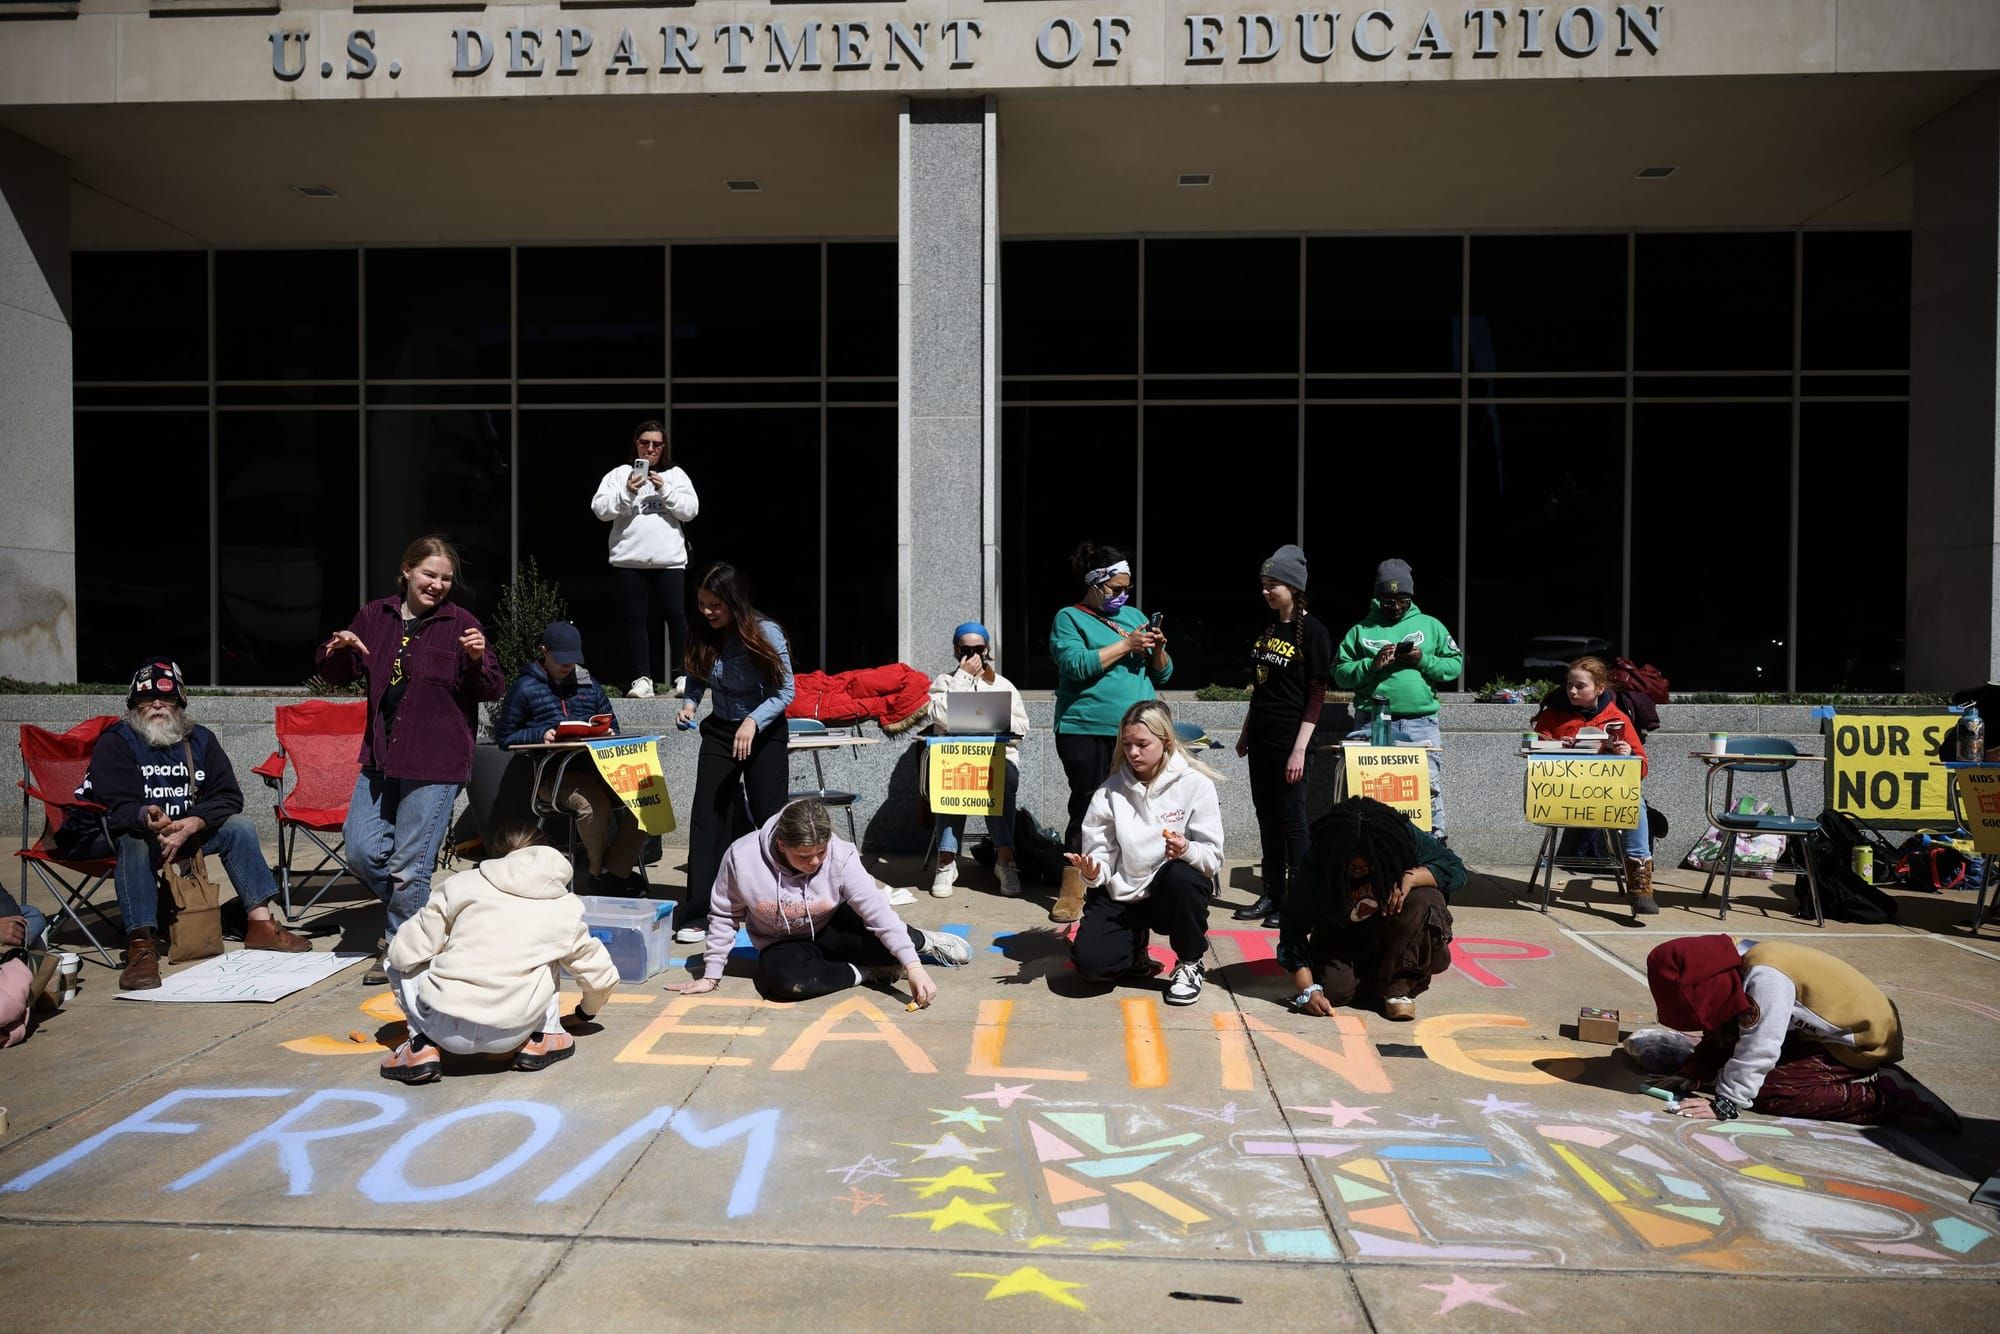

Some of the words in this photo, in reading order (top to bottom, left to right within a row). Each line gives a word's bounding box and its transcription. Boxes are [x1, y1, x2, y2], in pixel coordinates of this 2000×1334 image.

[267, 28, 402, 82] U.S.
[450, 19, 983, 78] DEPARTMENT
[1035, 17, 1132, 69] OF
[1183, 4, 1665, 65] EDUCATION
[940, 744, 960, 755] KIDS
[961, 745, 997, 756] DESERVE
[1836, 725, 1911, 757] OUR
[596, 747, 615, 760] KIDS
[615, 742, 648, 757] DESERVE
[1358, 755, 1379, 766] KIDS
[1381, 754, 1420, 766] DESERVE
[1589, 762, 1626, 777] CAN
[1968, 774, 1995, 784] KIDS
[1531, 781, 1564, 800] YOU
[1570, 783, 1614, 800] LOOK
[1620, 786, 1639, 801] US
[1838, 770, 1930, 811] NOT
[631, 794, 661, 809] SCHOOLS
[940, 796, 960, 807] GOOD
[962, 796, 996, 808] SCHOOLS
[1532, 804, 1552, 819] IN
[1561, 805, 1597, 821] THE
[1603, 805, 1640, 825] EYES?
[280, 991, 1584, 1095] SEALING
[1, 1087, 782, 1219] FROM
